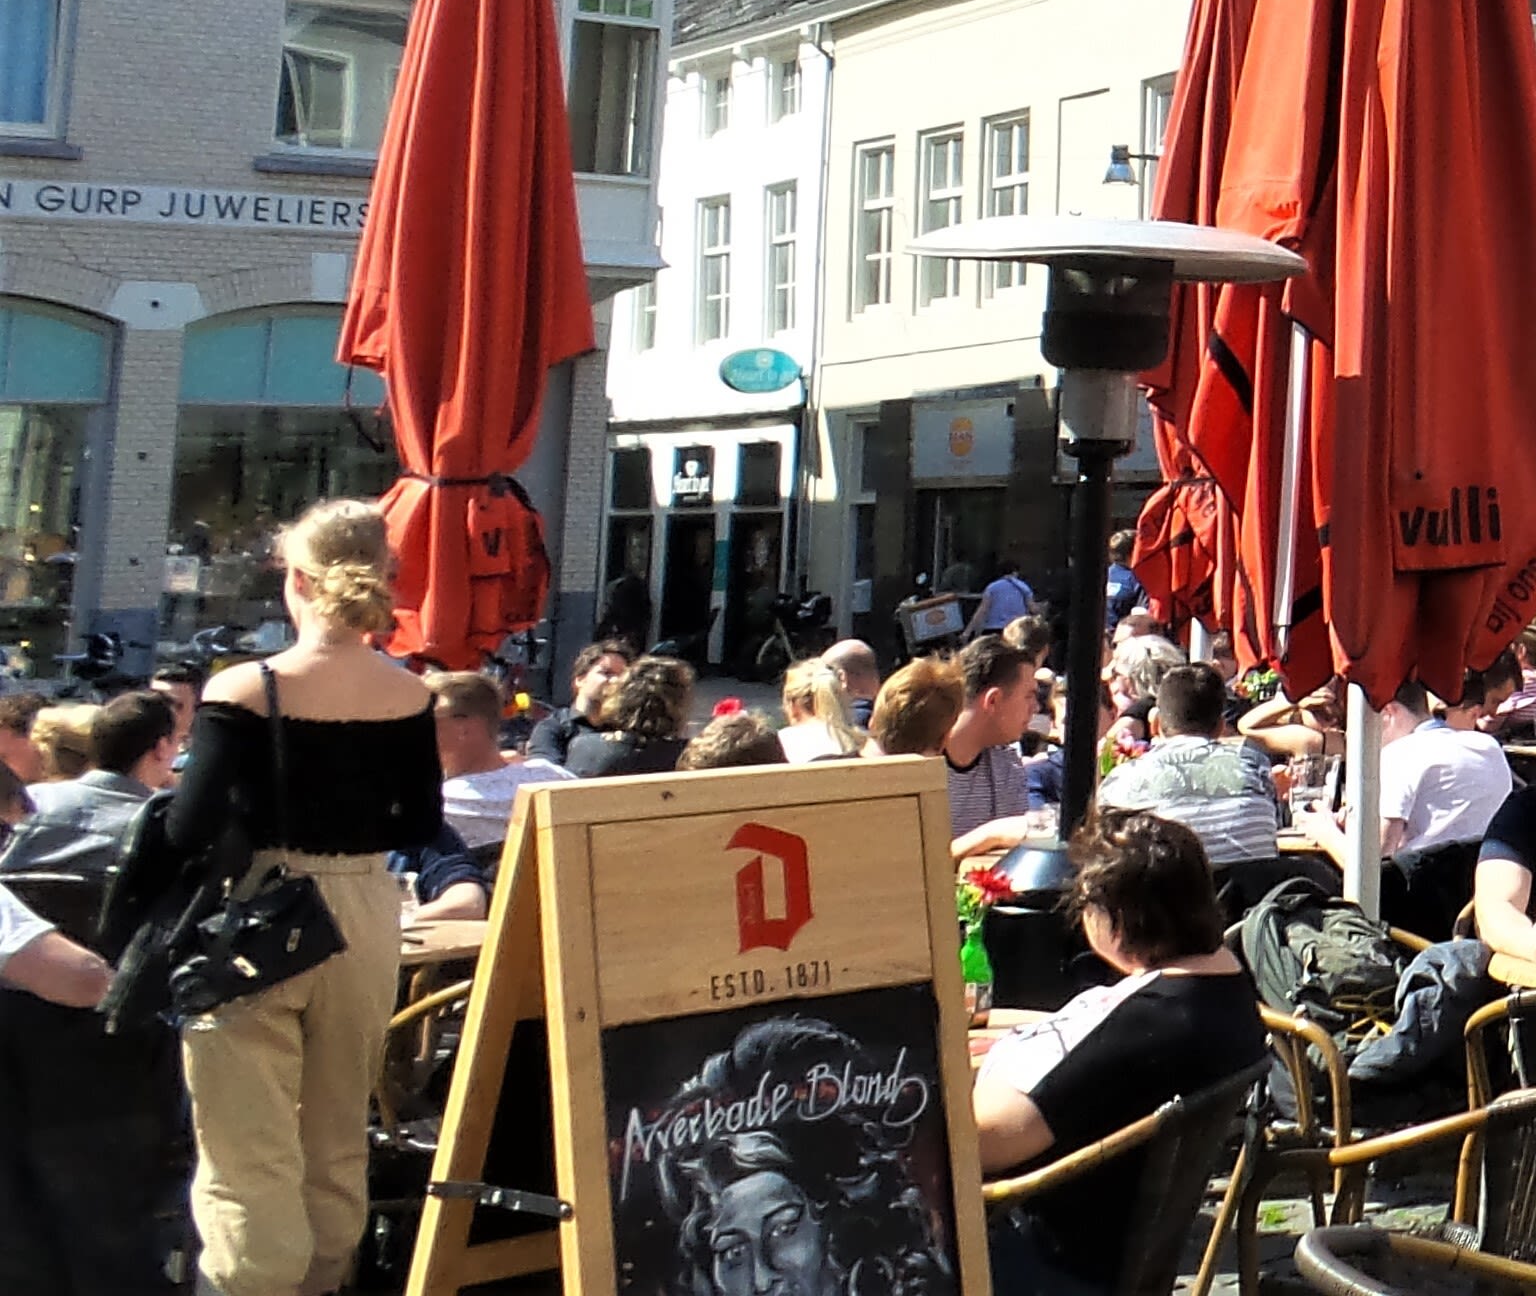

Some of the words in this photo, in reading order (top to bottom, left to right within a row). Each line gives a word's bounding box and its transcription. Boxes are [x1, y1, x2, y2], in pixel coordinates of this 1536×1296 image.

[35, 185, 142, 216] GURP
[160, 191, 370, 228] JUWELIERS
[710, 968, 776, 1001] ESTD.
[784, 959, 832, 990] 1871
